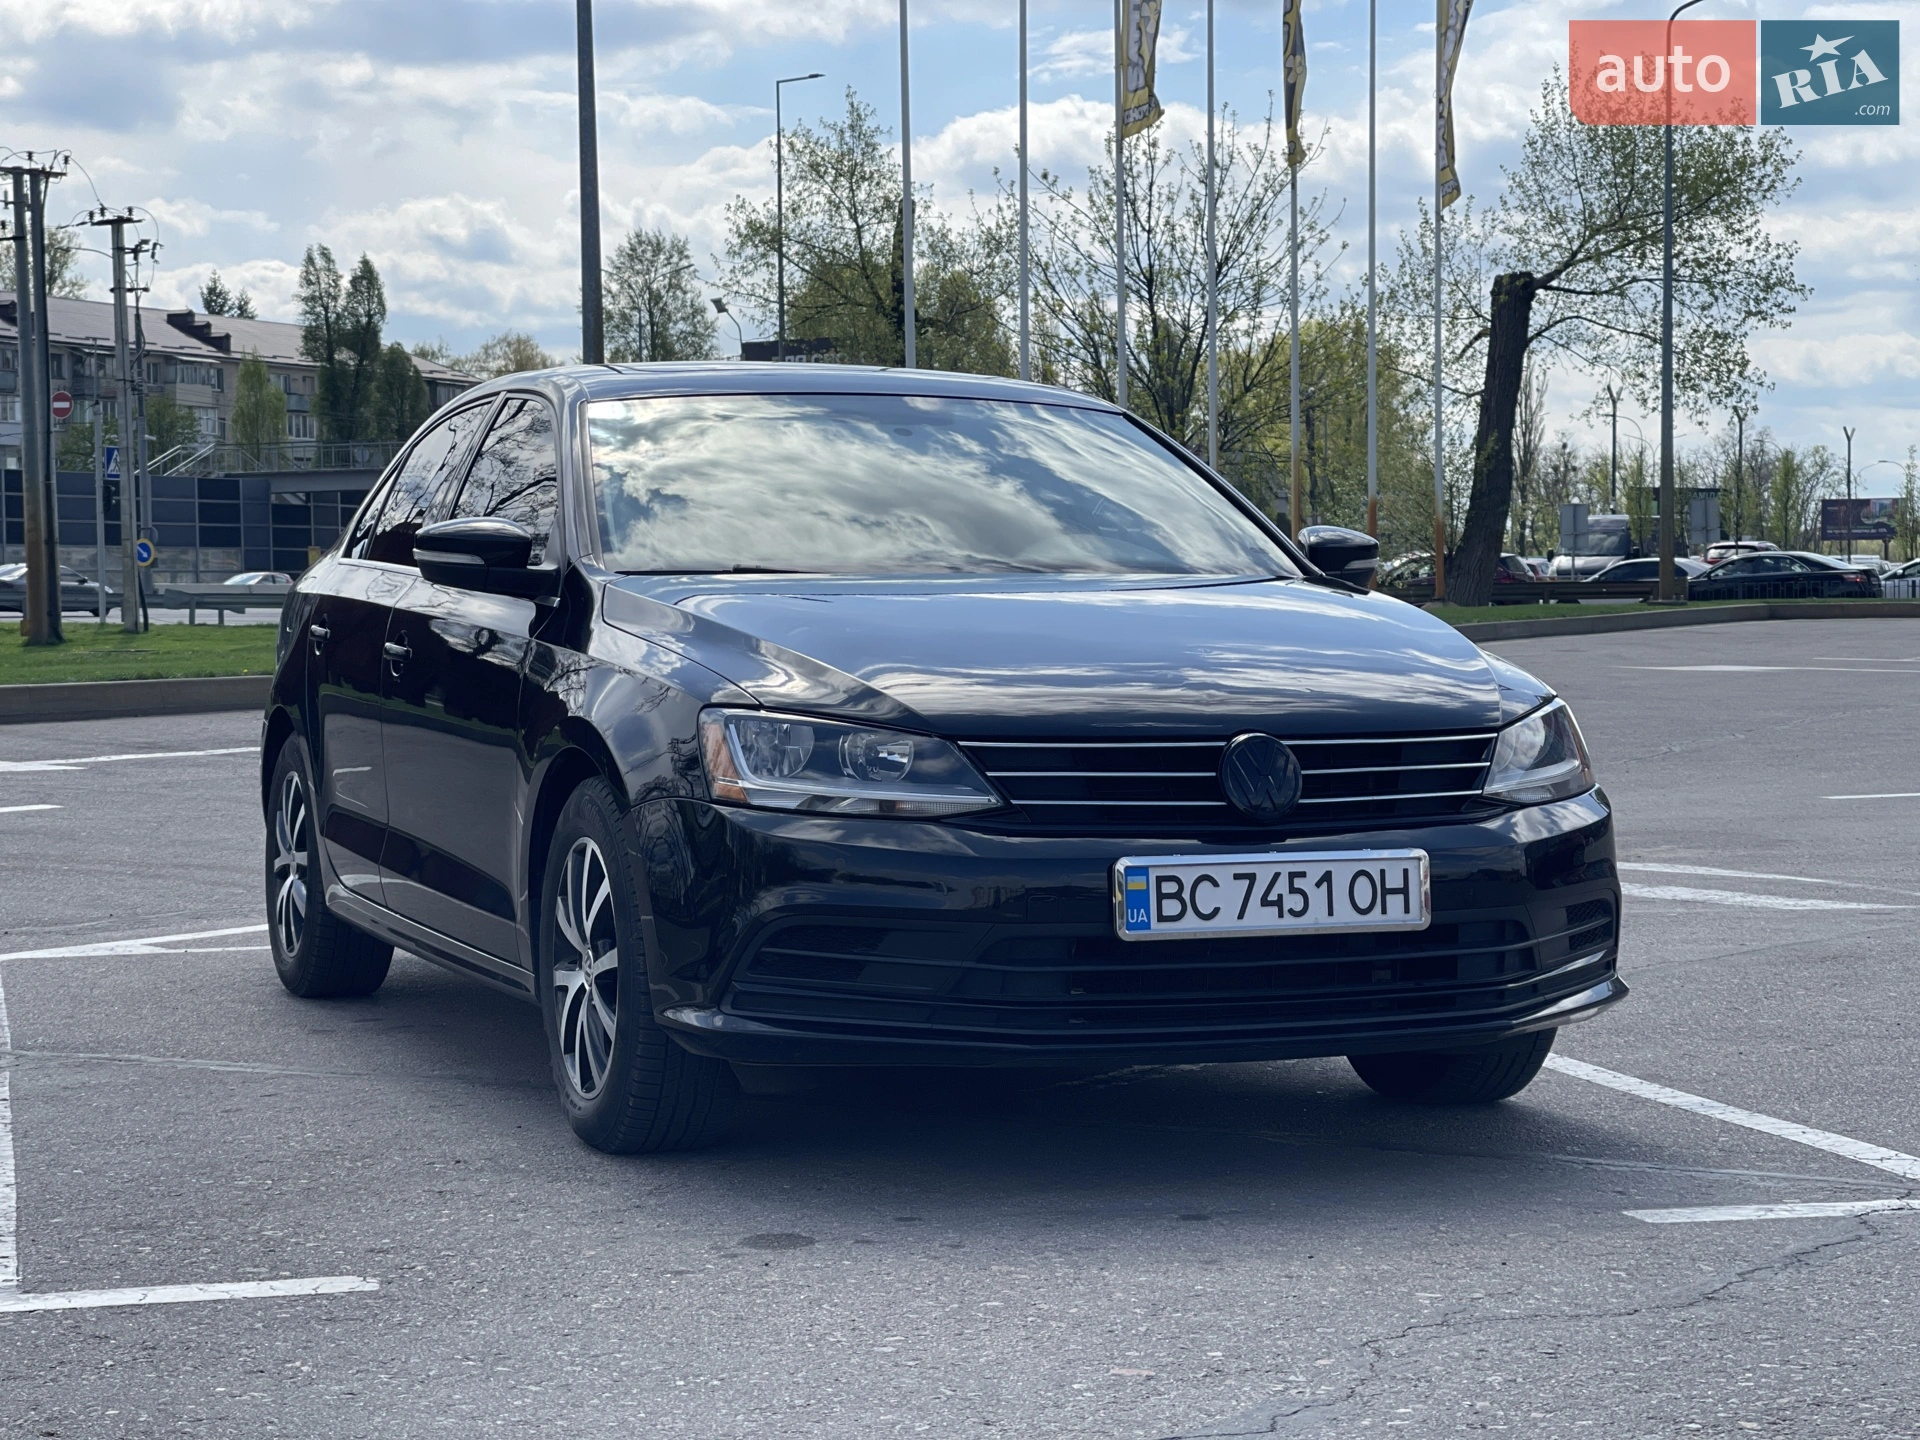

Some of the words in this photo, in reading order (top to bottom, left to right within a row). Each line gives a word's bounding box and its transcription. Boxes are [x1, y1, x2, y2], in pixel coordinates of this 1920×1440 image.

[1155, 873, 1221, 923] BC
[1233, 869, 1334, 921] 7451
[1348, 867, 1411, 916] OH
[1127, 908, 1148, 924] UA
